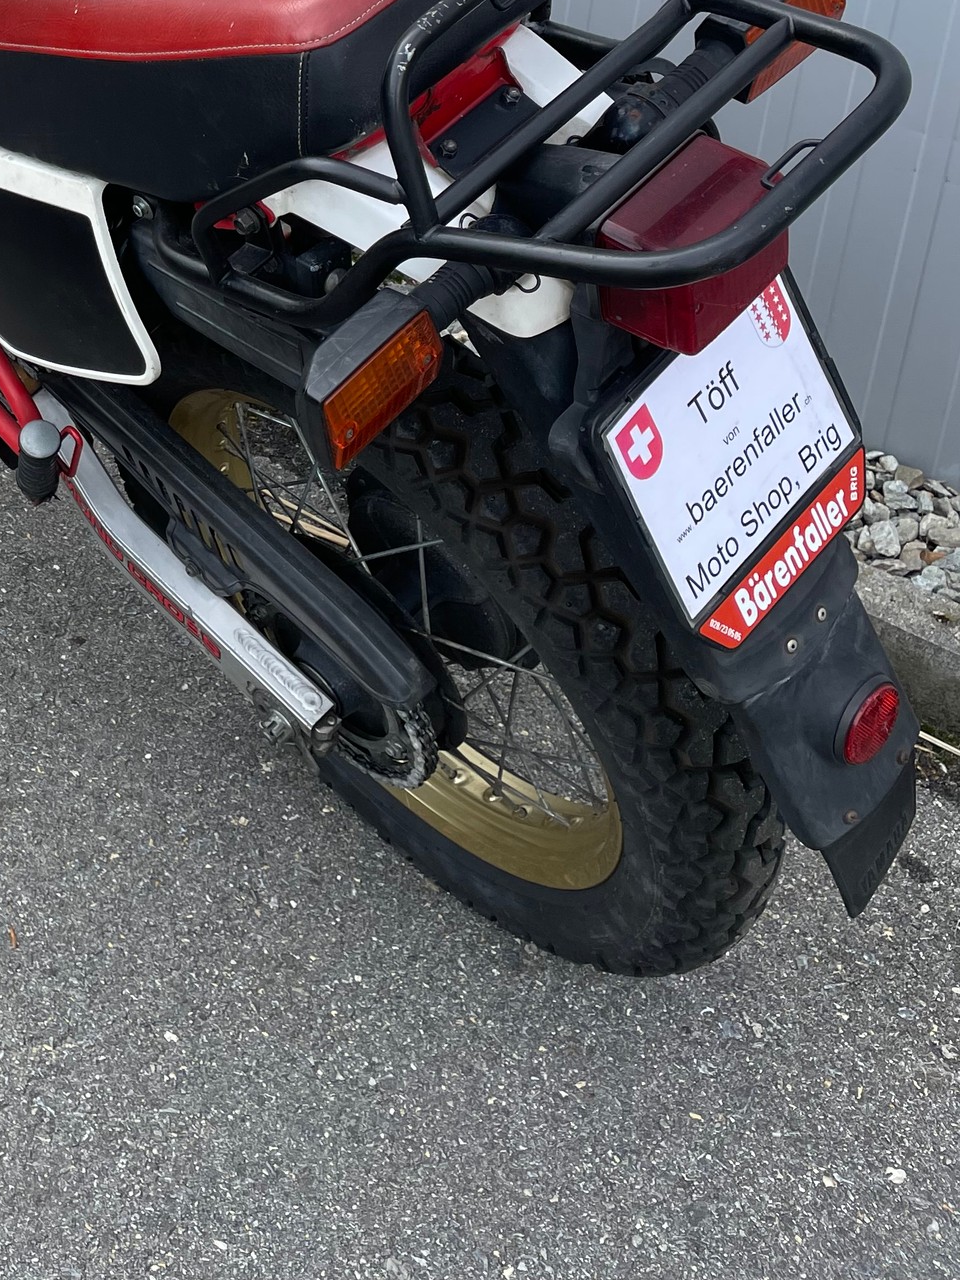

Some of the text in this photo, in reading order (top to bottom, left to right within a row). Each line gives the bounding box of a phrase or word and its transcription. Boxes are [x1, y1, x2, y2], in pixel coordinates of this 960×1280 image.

[687, 360, 740, 424] Töff
[722, 426, 740, 445] von
[685, 423, 842, 599] Moto Shop, Brig
[734, 466, 858, 627] Bärenfaller BRIG
